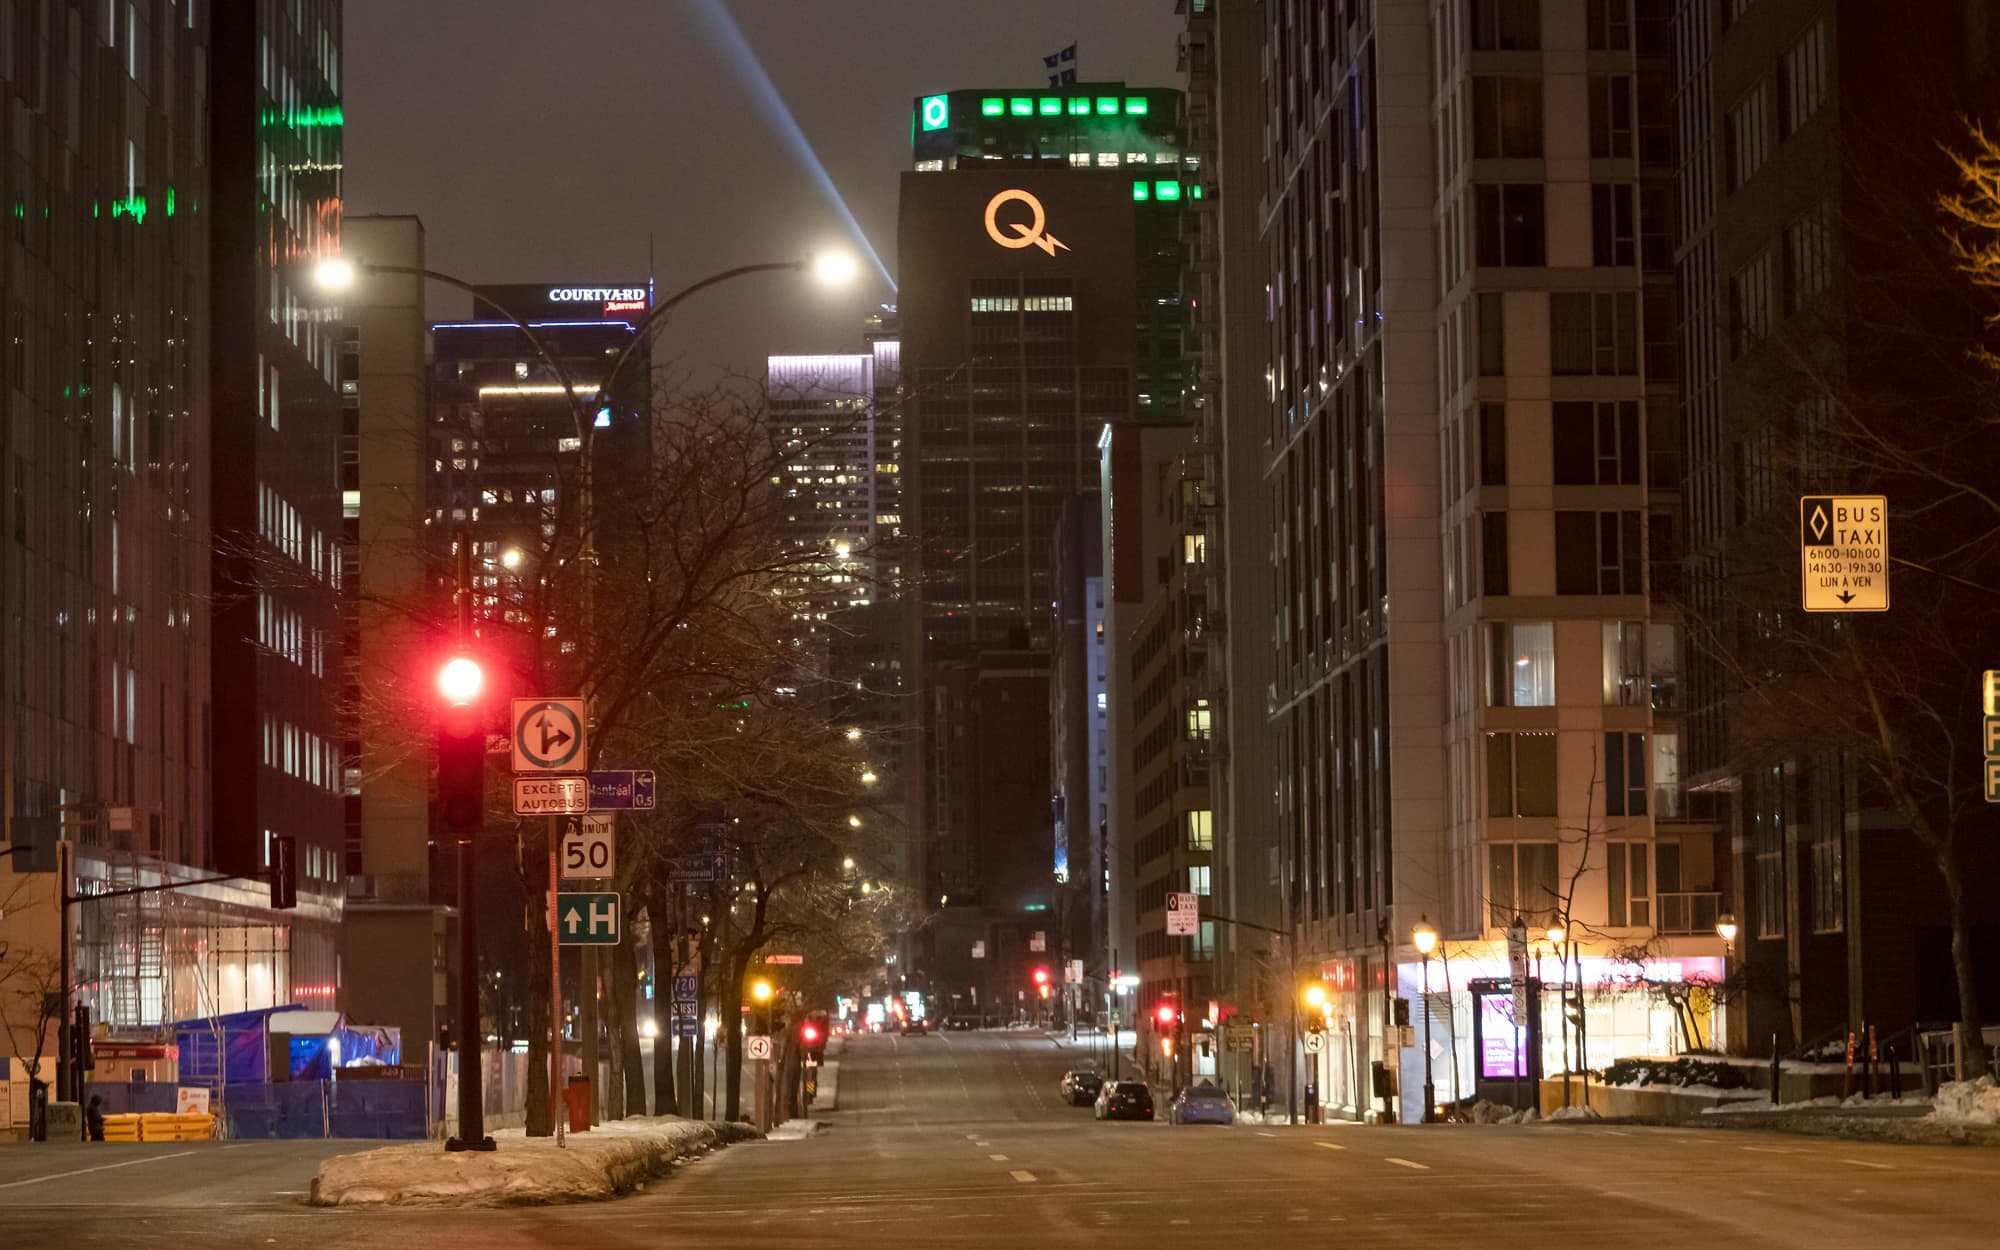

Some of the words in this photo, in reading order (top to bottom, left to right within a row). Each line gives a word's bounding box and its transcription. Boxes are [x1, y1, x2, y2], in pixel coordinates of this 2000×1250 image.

[549, 288, 645, 301] COURTYARD
[1837, 507, 1881, 523] BUS
[1837, 529, 1881, 545] TAXI
[1820, 577, 1838, 588] LUN
[1852, 577, 1872, 588] VEN
[522, 798, 585, 809] AUTOBUS
[567, 823, 609, 833] MIMUM
[567, 841, 609, 869] 50
[589, 902, 616, 935] H
